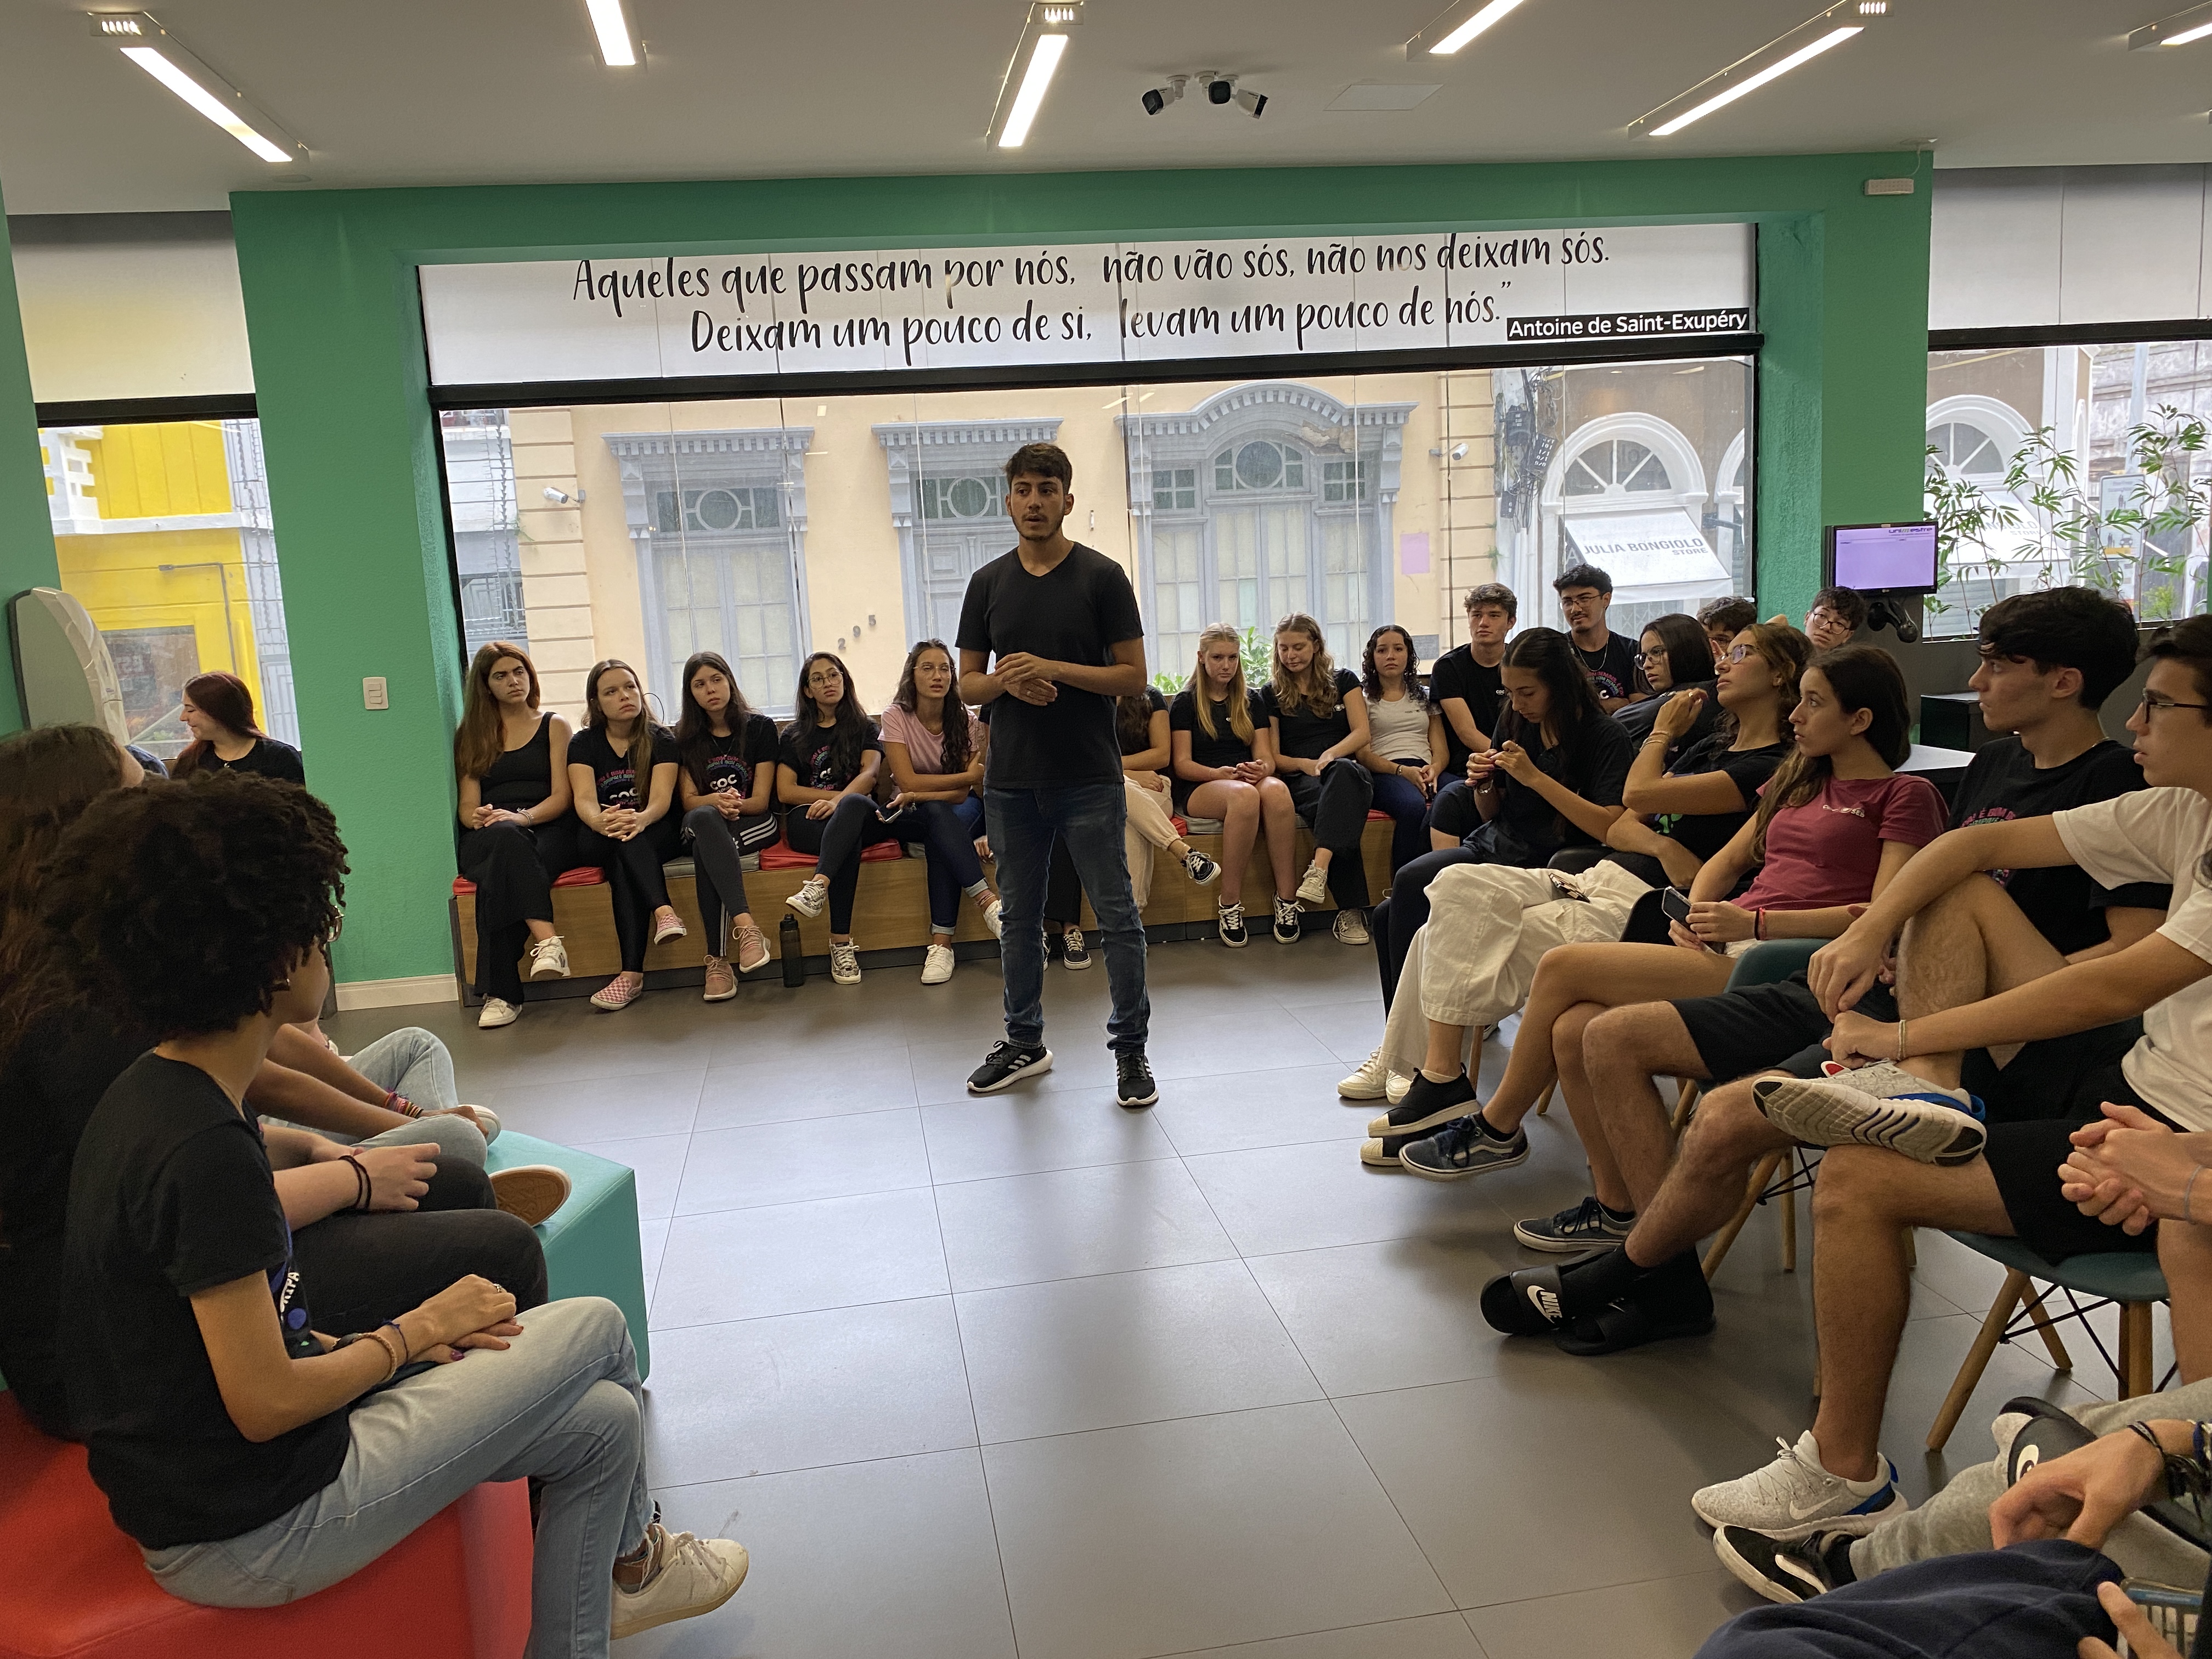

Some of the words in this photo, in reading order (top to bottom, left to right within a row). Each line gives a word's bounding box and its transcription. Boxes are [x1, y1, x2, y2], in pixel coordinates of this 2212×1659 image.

[573, 257, 709, 318] Aqueles
[722, 263, 786, 313] que
[798, 259, 932, 314] passam
[945, 258, 1003, 309] por
[1015, 250, 1076, 287] nós,
[1103, 250, 1164, 284] não
[1174, 249, 1233, 281] vão
[1243, 243, 1295, 279] sós,
[1307, 243, 1365, 275] não
[1376, 241, 1426, 273] nos
[1437, 233, 1550, 270] deixam
[1561, 232, 1609, 264] sós.
[691, 310, 821, 353] Deixam
[834, 319, 891, 348] um
[904, 313, 1002, 366] pouco
[1013, 300, 1051, 343] de
[1062, 307, 1092, 341] si,
[1121, 298, 1220, 340] levam
[1231, 303, 1284, 334] um
[1296, 300, 1388, 351] pouco
[1399, 285, 1434, 327] de
[1509, 319, 1583, 337] Antoine
[1588, 317, 1612, 334] de
[1616, 311, 1748, 333] Saint-Exupéry
[1584, 543, 1626, 554] JULIA
[1627, 538, 1704, 552] BONGIOLO
[1672, 547, 1709, 556] STORE
[1540, 1291, 1562, 1318] NIKE
